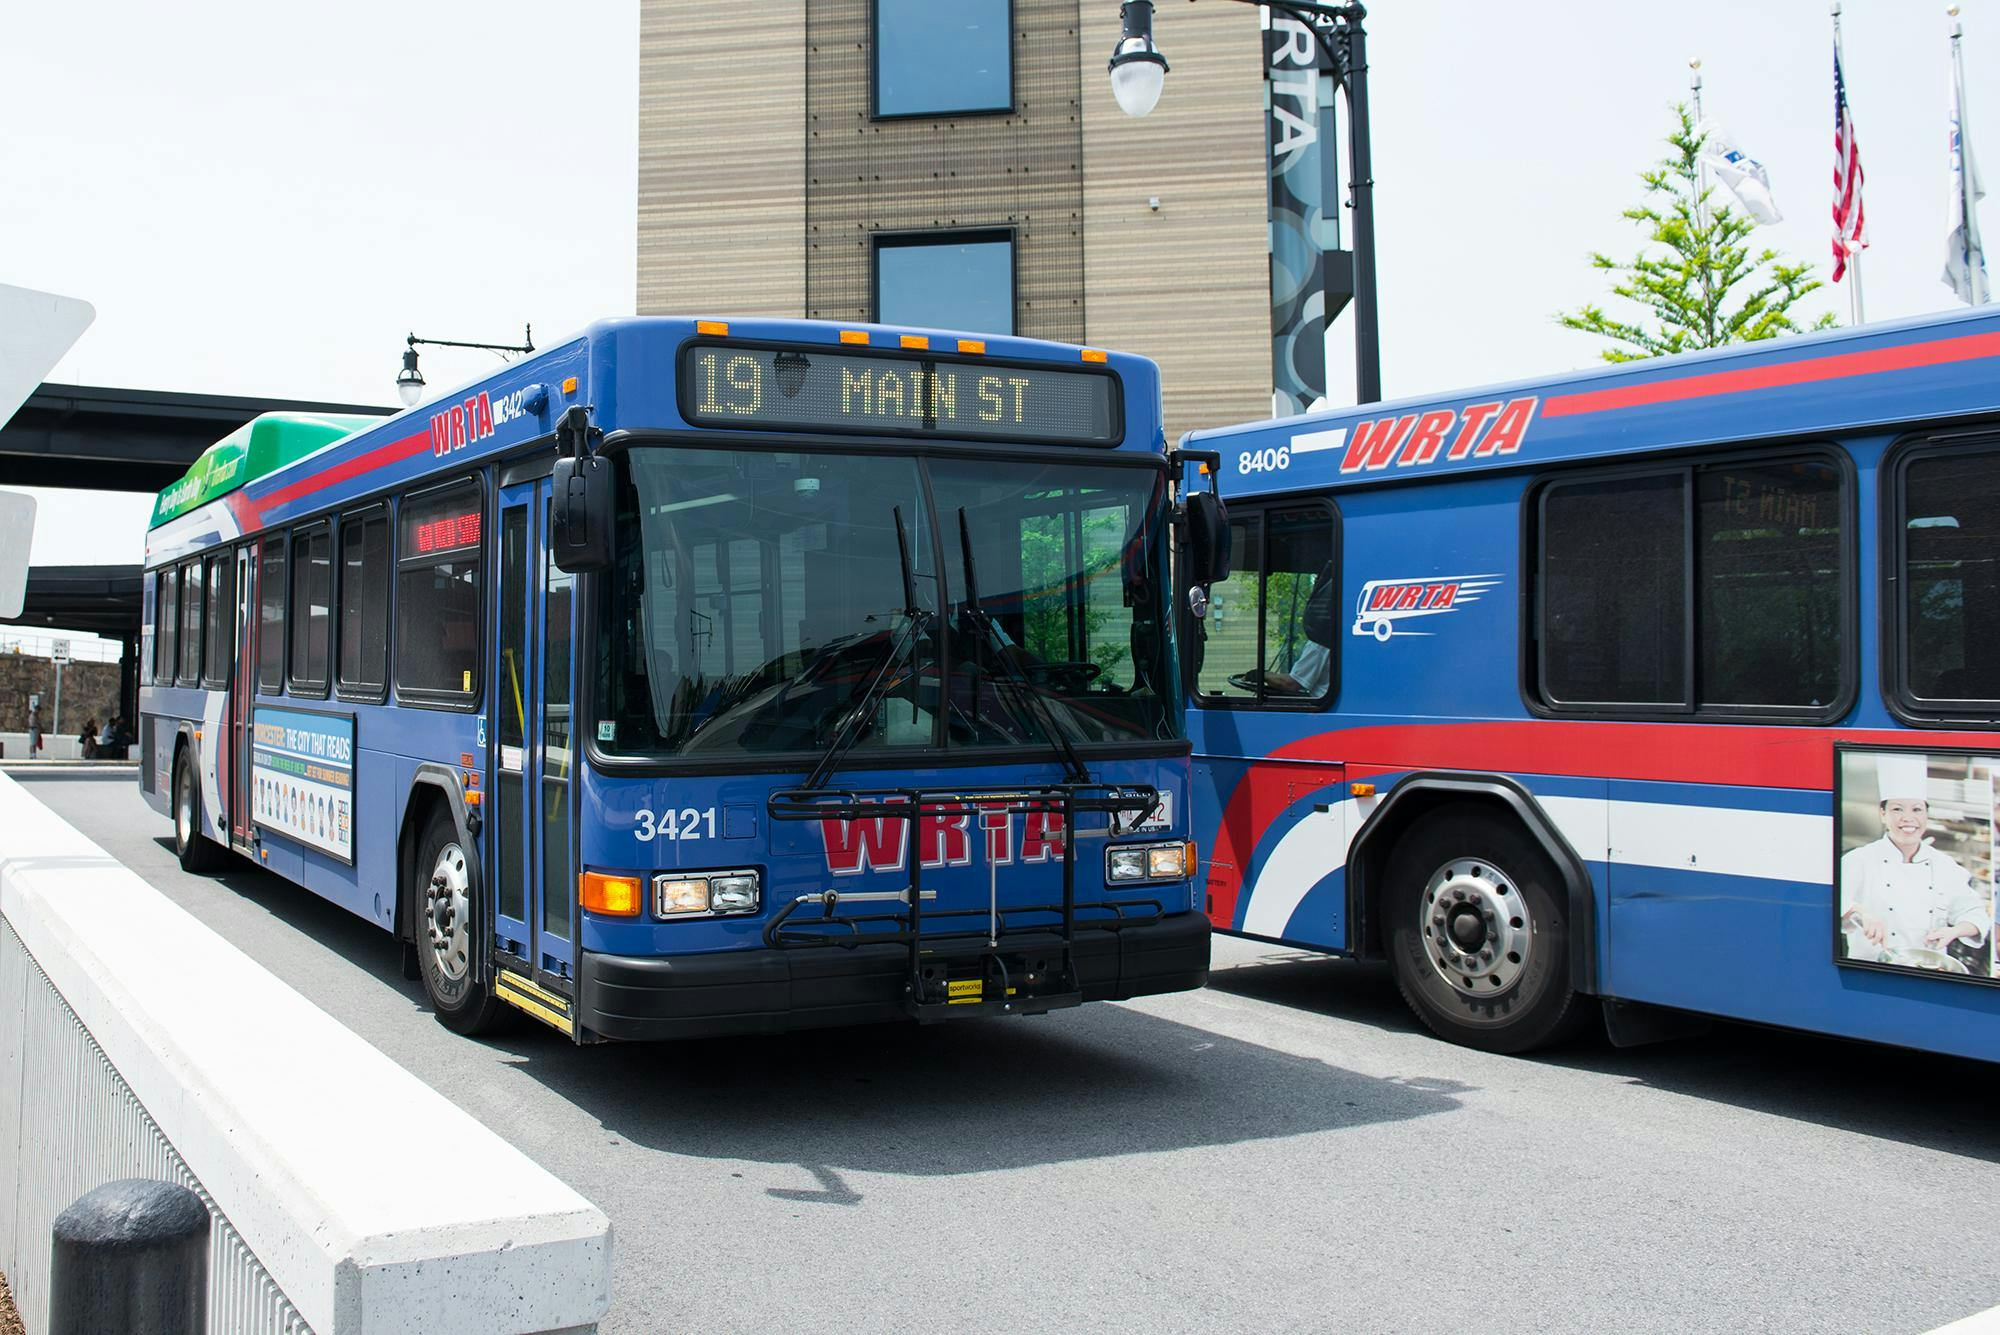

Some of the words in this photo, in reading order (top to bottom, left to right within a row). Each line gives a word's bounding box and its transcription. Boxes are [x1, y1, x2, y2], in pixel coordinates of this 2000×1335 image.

[699, 354, 761, 415] 19
[842, 367, 956, 419] MAIN
[978, 375, 1029, 423] ST
[430, 390, 495, 458] WRTA
[502, 390, 526, 424] 342
[1340, 395, 1539, 475] WRTA
[1238, 446, 1290, 475] 8406
[1370, 583, 1459, 611] WRTA
[286, 728, 297, 750] THE
[298, 730, 311, 753] CITY
[311, 731, 326, 756] THAT
[327, 735, 350, 761] READS
[634, 807, 716, 842] 3421
[816, 791, 1078, 876] WRTA
